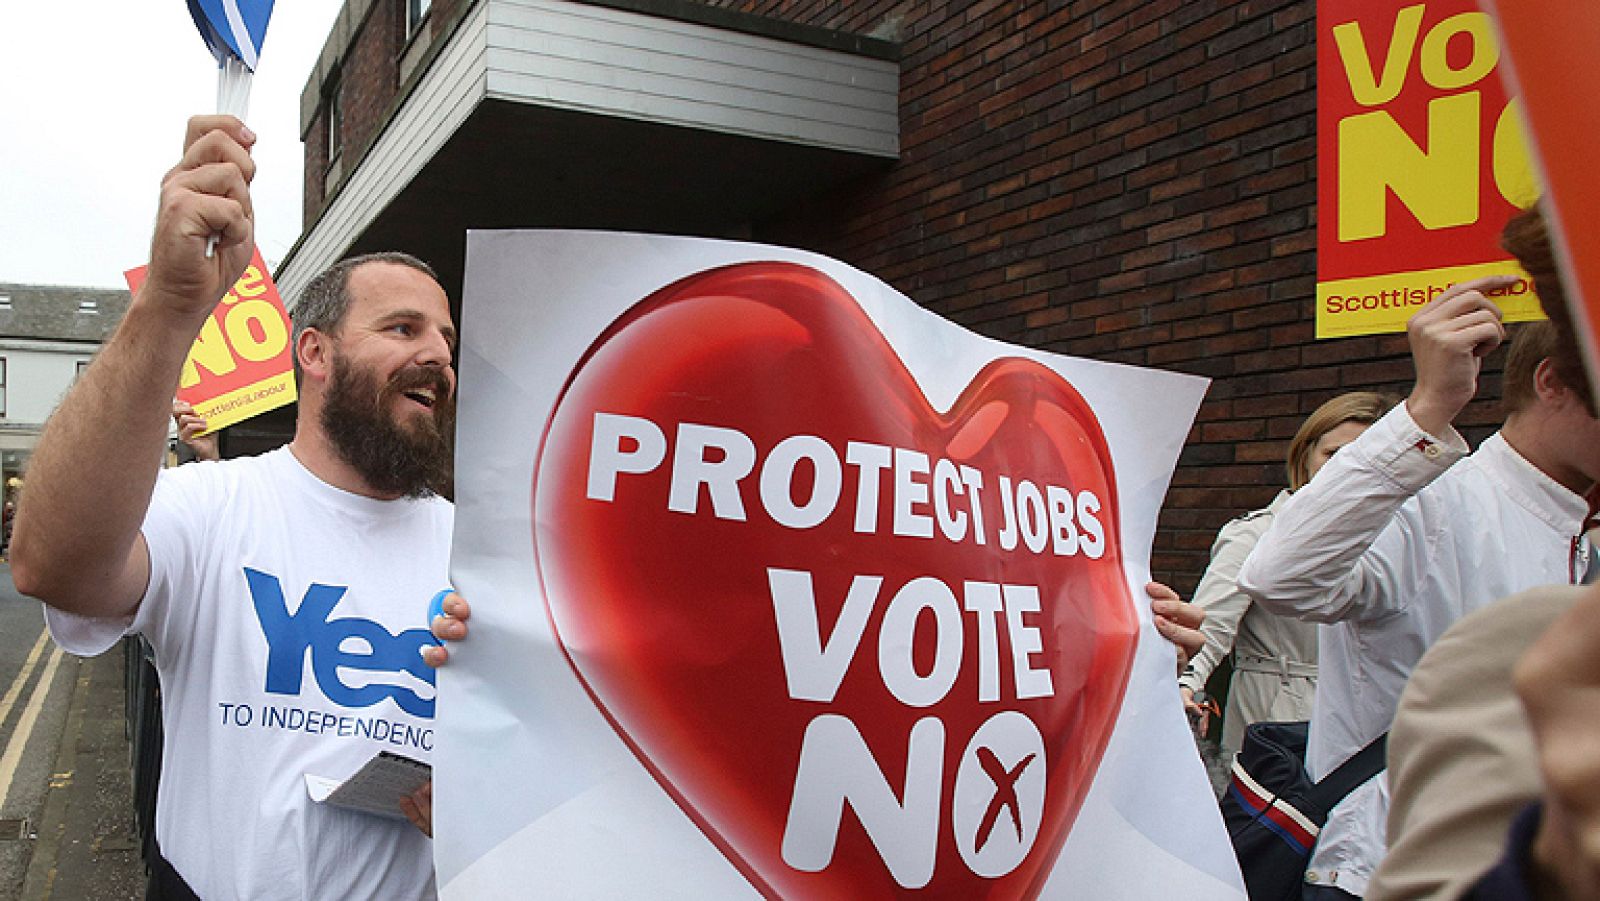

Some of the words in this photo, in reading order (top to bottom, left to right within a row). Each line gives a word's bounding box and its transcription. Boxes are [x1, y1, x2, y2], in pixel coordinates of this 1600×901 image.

[1332, 3, 1501, 107] Vo
[199, 398, 239, 419] ottish
[586, 412, 987, 546] PROTECT
[998, 475, 1106, 560] JOBS
[243, 566, 436, 719] Yes
[766, 567, 1055, 708] VOTE
[218, 703, 253, 727] TO
[261, 706, 435, 751] INDEPENDENC
[780, 710, 1048, 890] NO
